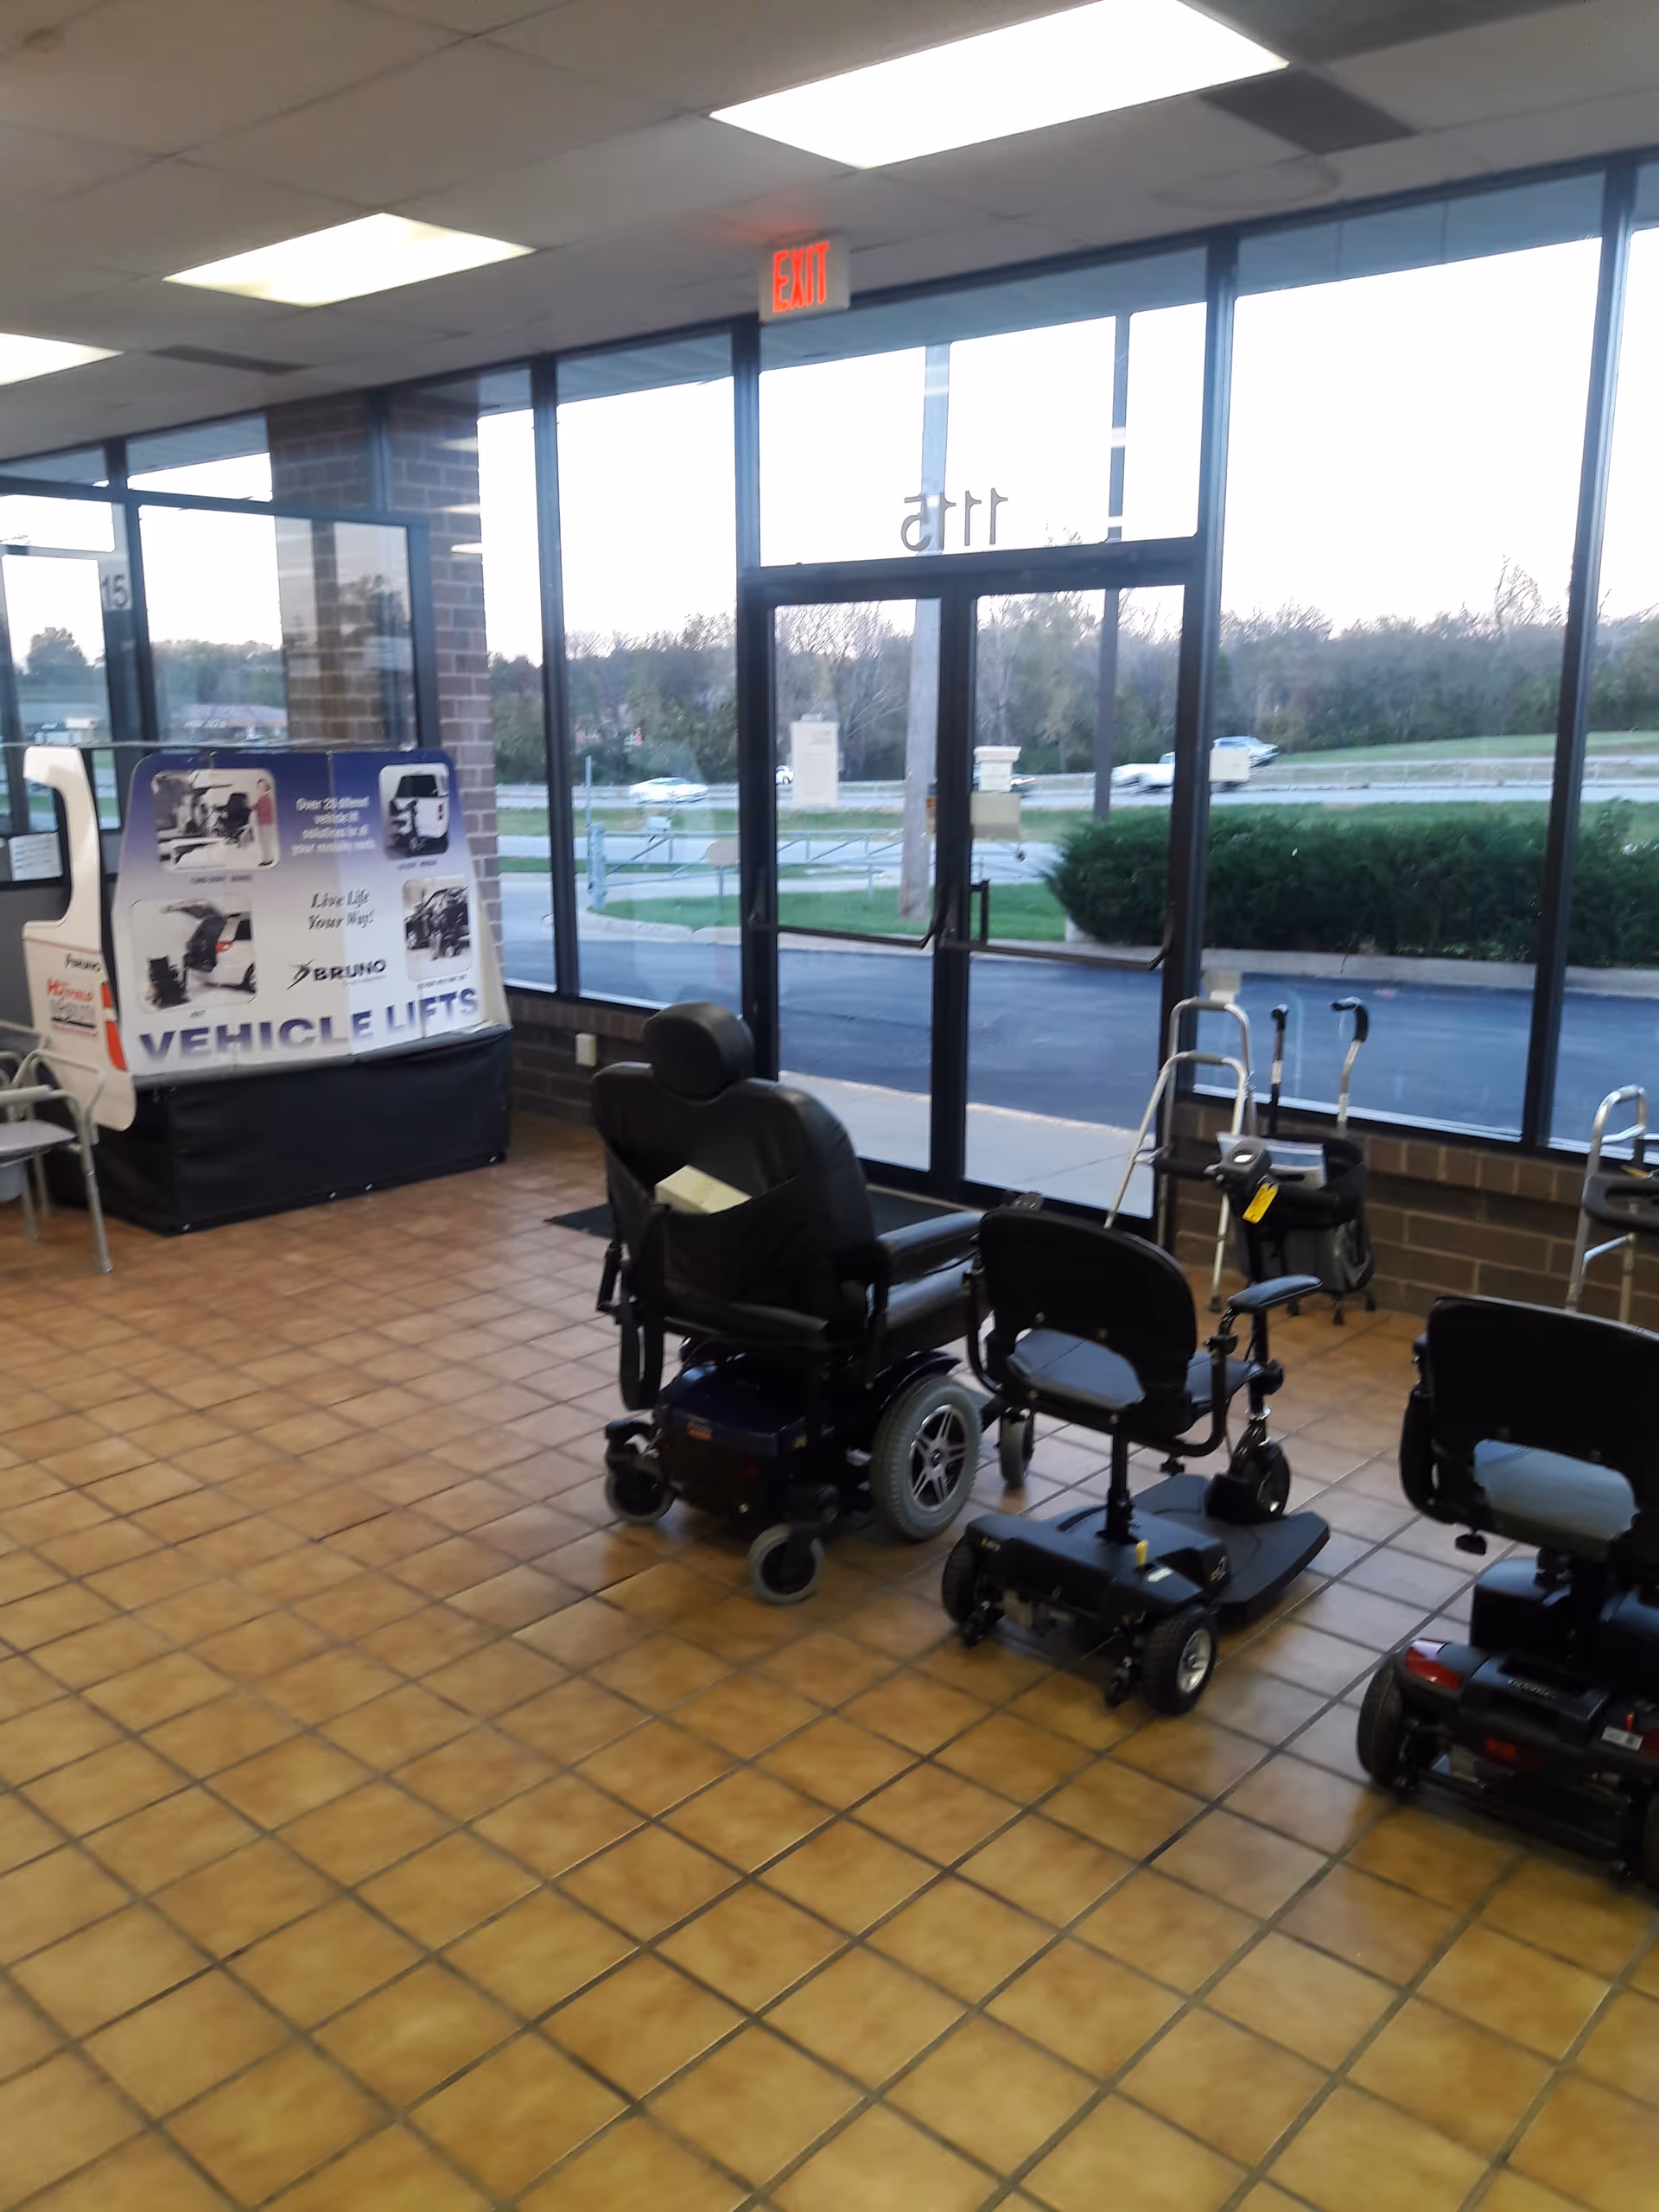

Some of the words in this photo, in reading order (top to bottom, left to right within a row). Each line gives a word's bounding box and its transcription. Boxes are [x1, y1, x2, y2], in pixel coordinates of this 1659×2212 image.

[772, 241, 830, 314] EXIT
[310, 893, 346, 908] Live
[308, 913, 345, 930] Your
[314, 959, 387, 982] BRUNO
[138, 1010, 372, 1062] VEHICLE
[386, 988, 479, 1033] LIFTS
